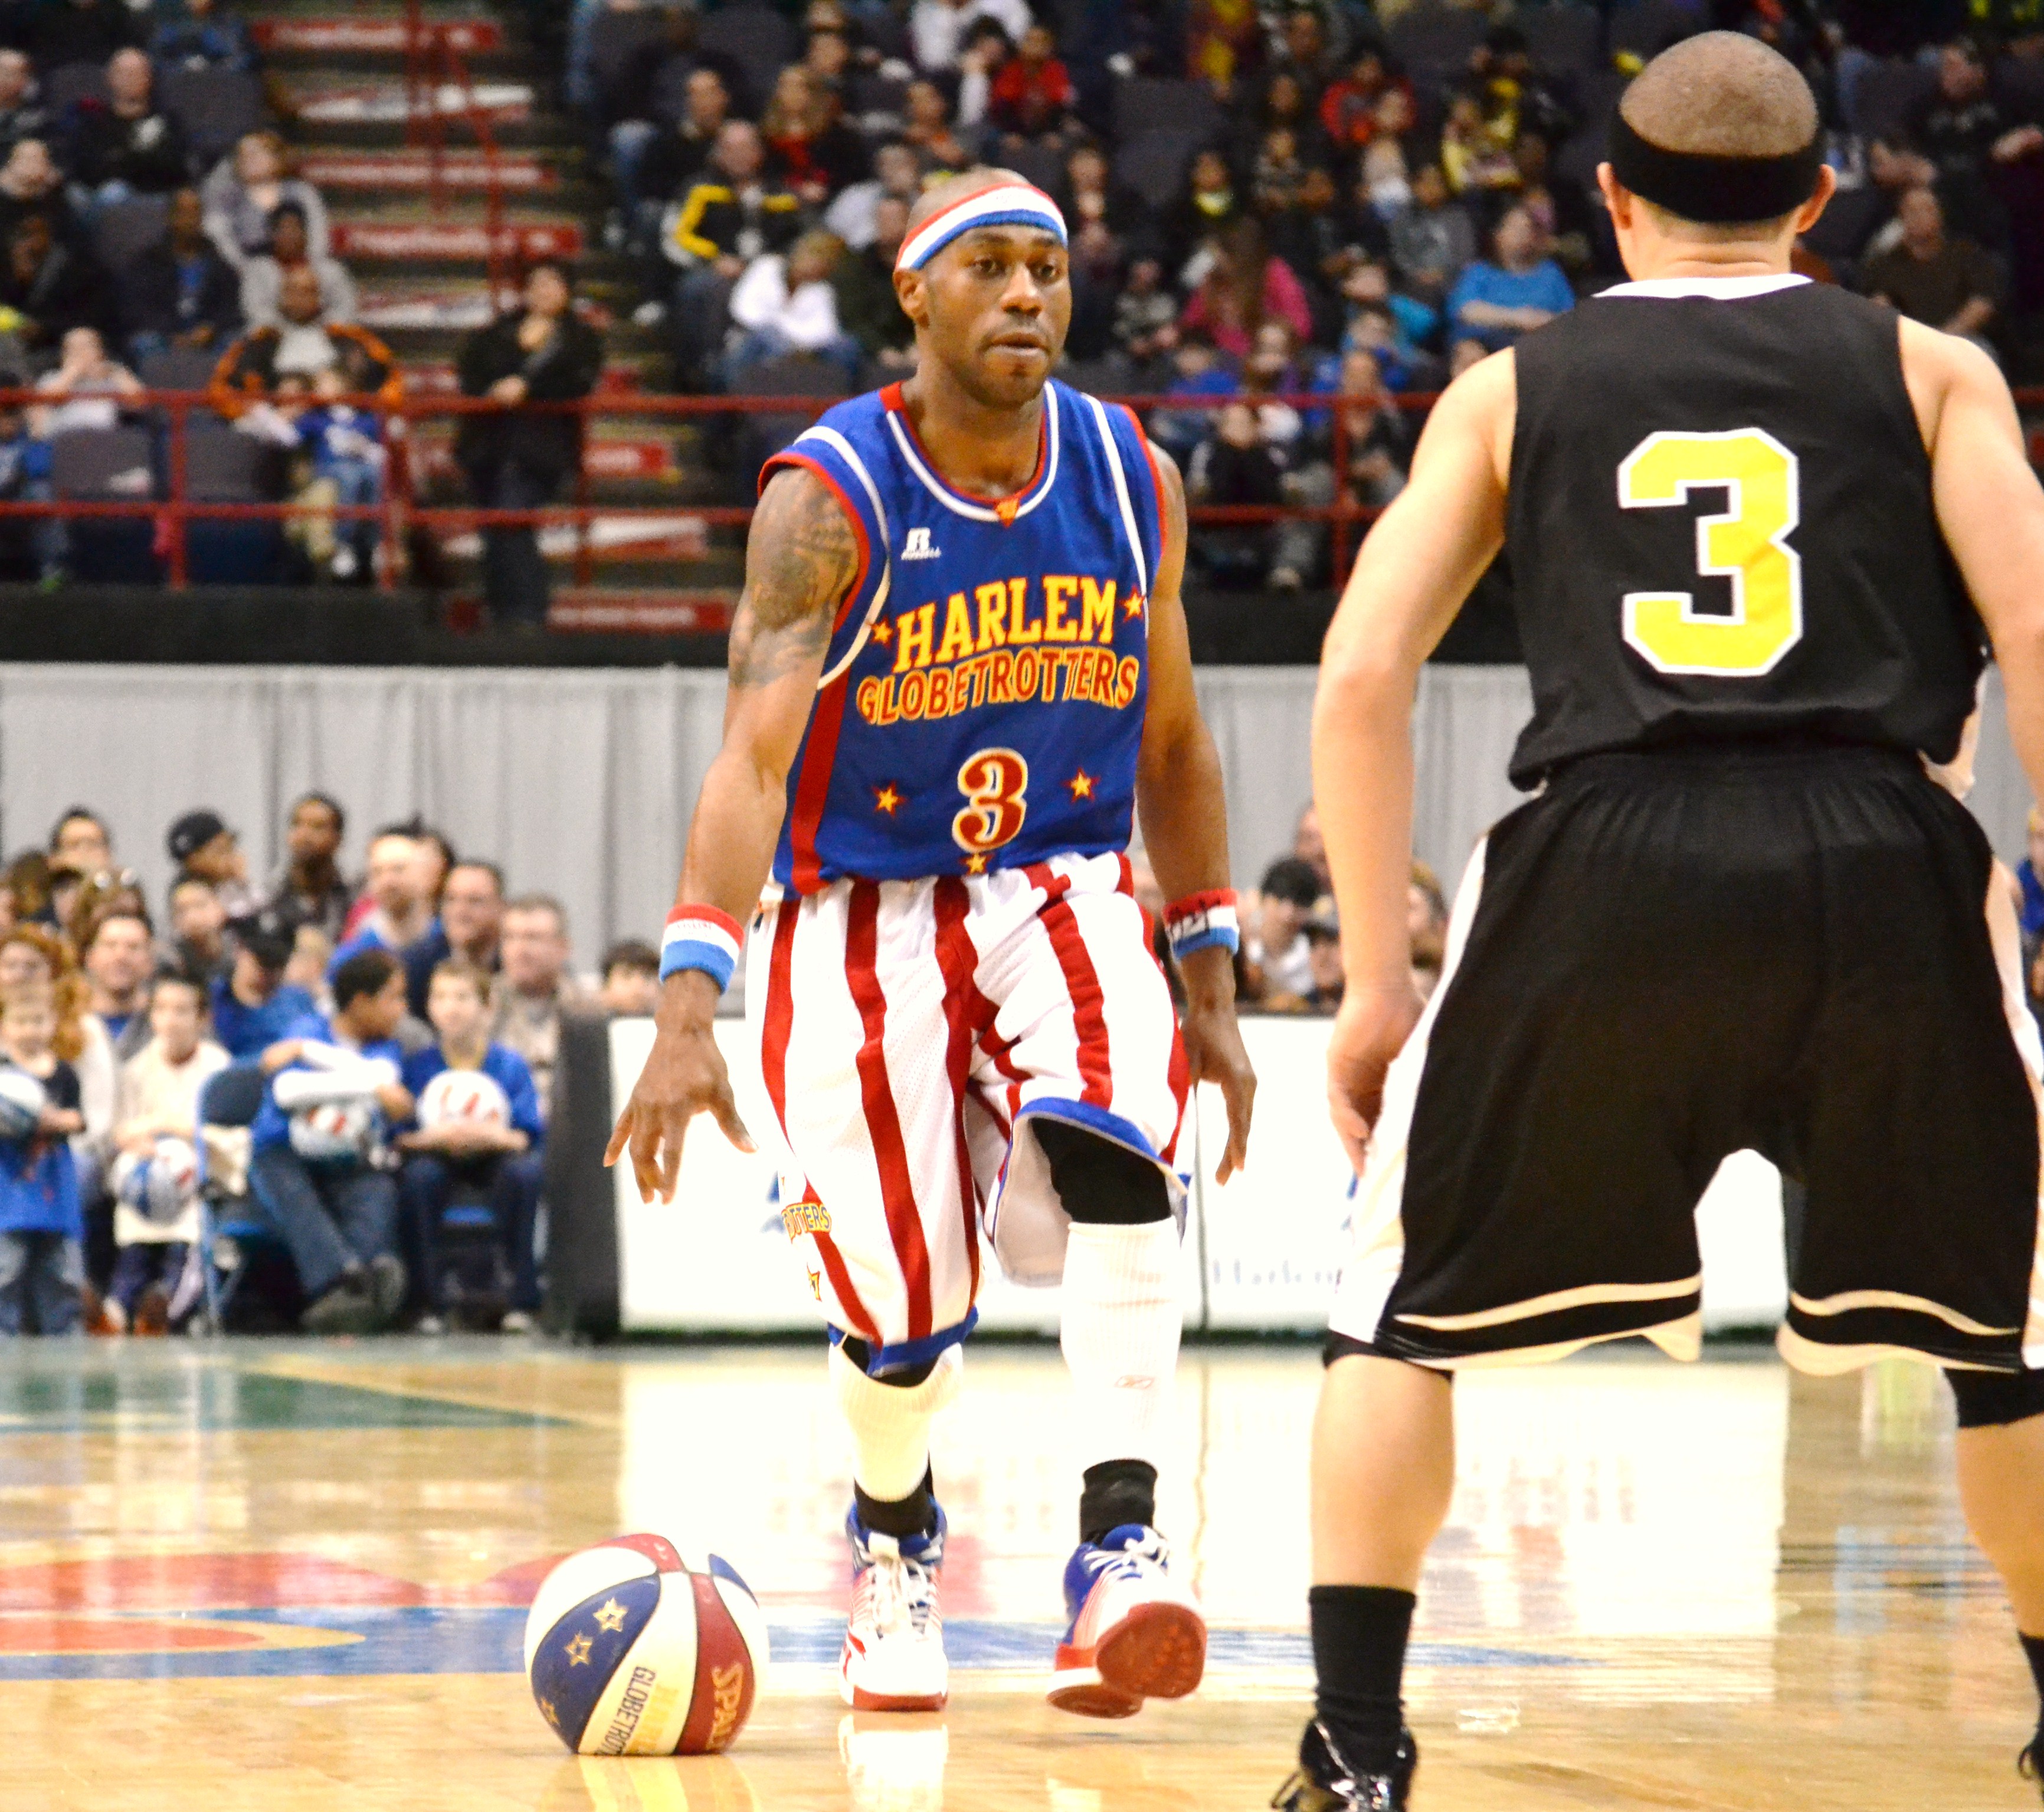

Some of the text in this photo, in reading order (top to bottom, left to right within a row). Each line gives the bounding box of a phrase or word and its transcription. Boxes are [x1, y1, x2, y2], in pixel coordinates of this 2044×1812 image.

[1617, 426, 1803, 677] 3
[892, 575, 1116, 673] HARLEM
[856, 646, 1139, 725] GLOBETROTTERS
[952, 747, 1028, 853] 3
